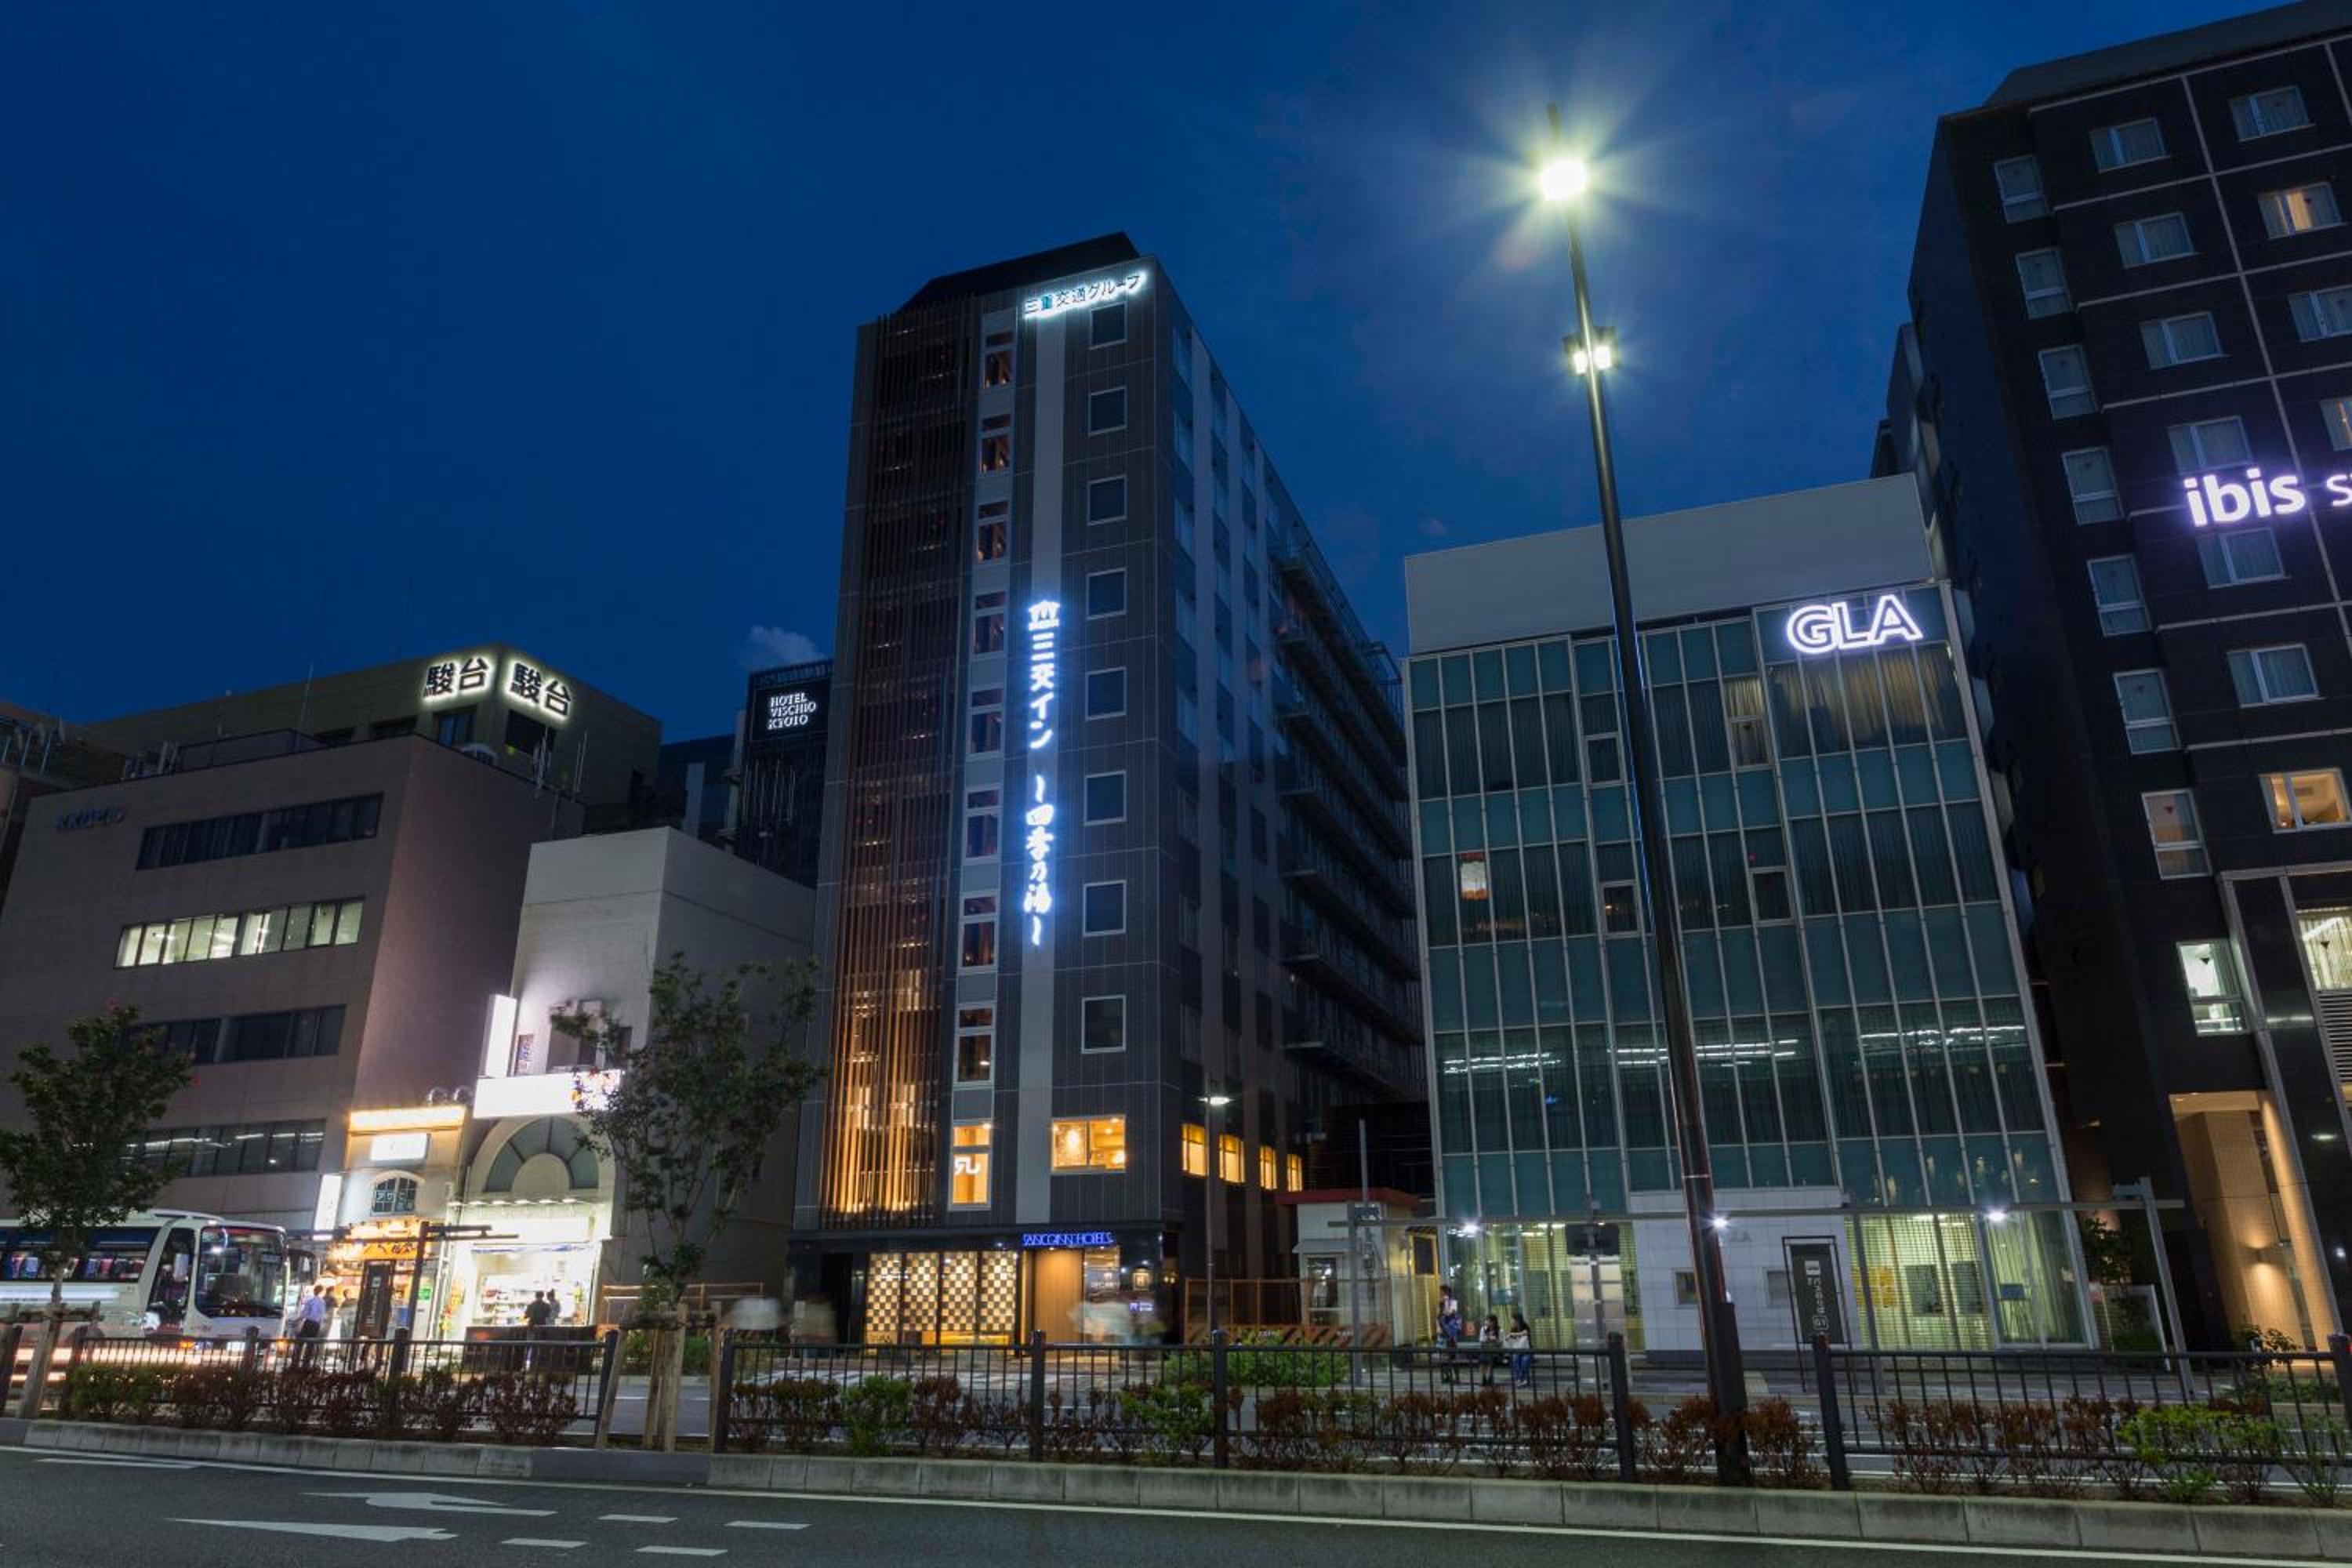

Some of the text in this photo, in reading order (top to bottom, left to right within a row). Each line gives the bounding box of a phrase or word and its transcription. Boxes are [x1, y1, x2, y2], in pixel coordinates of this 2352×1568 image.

[2183, 468, 2352, 527] ibis s
[1787, 593, 1923, 654] GLA
[424, 657, 489, 697] 駿台
[509, 662, 571, 716] 駿台
[770, 692, 808, 707] HOTEL
